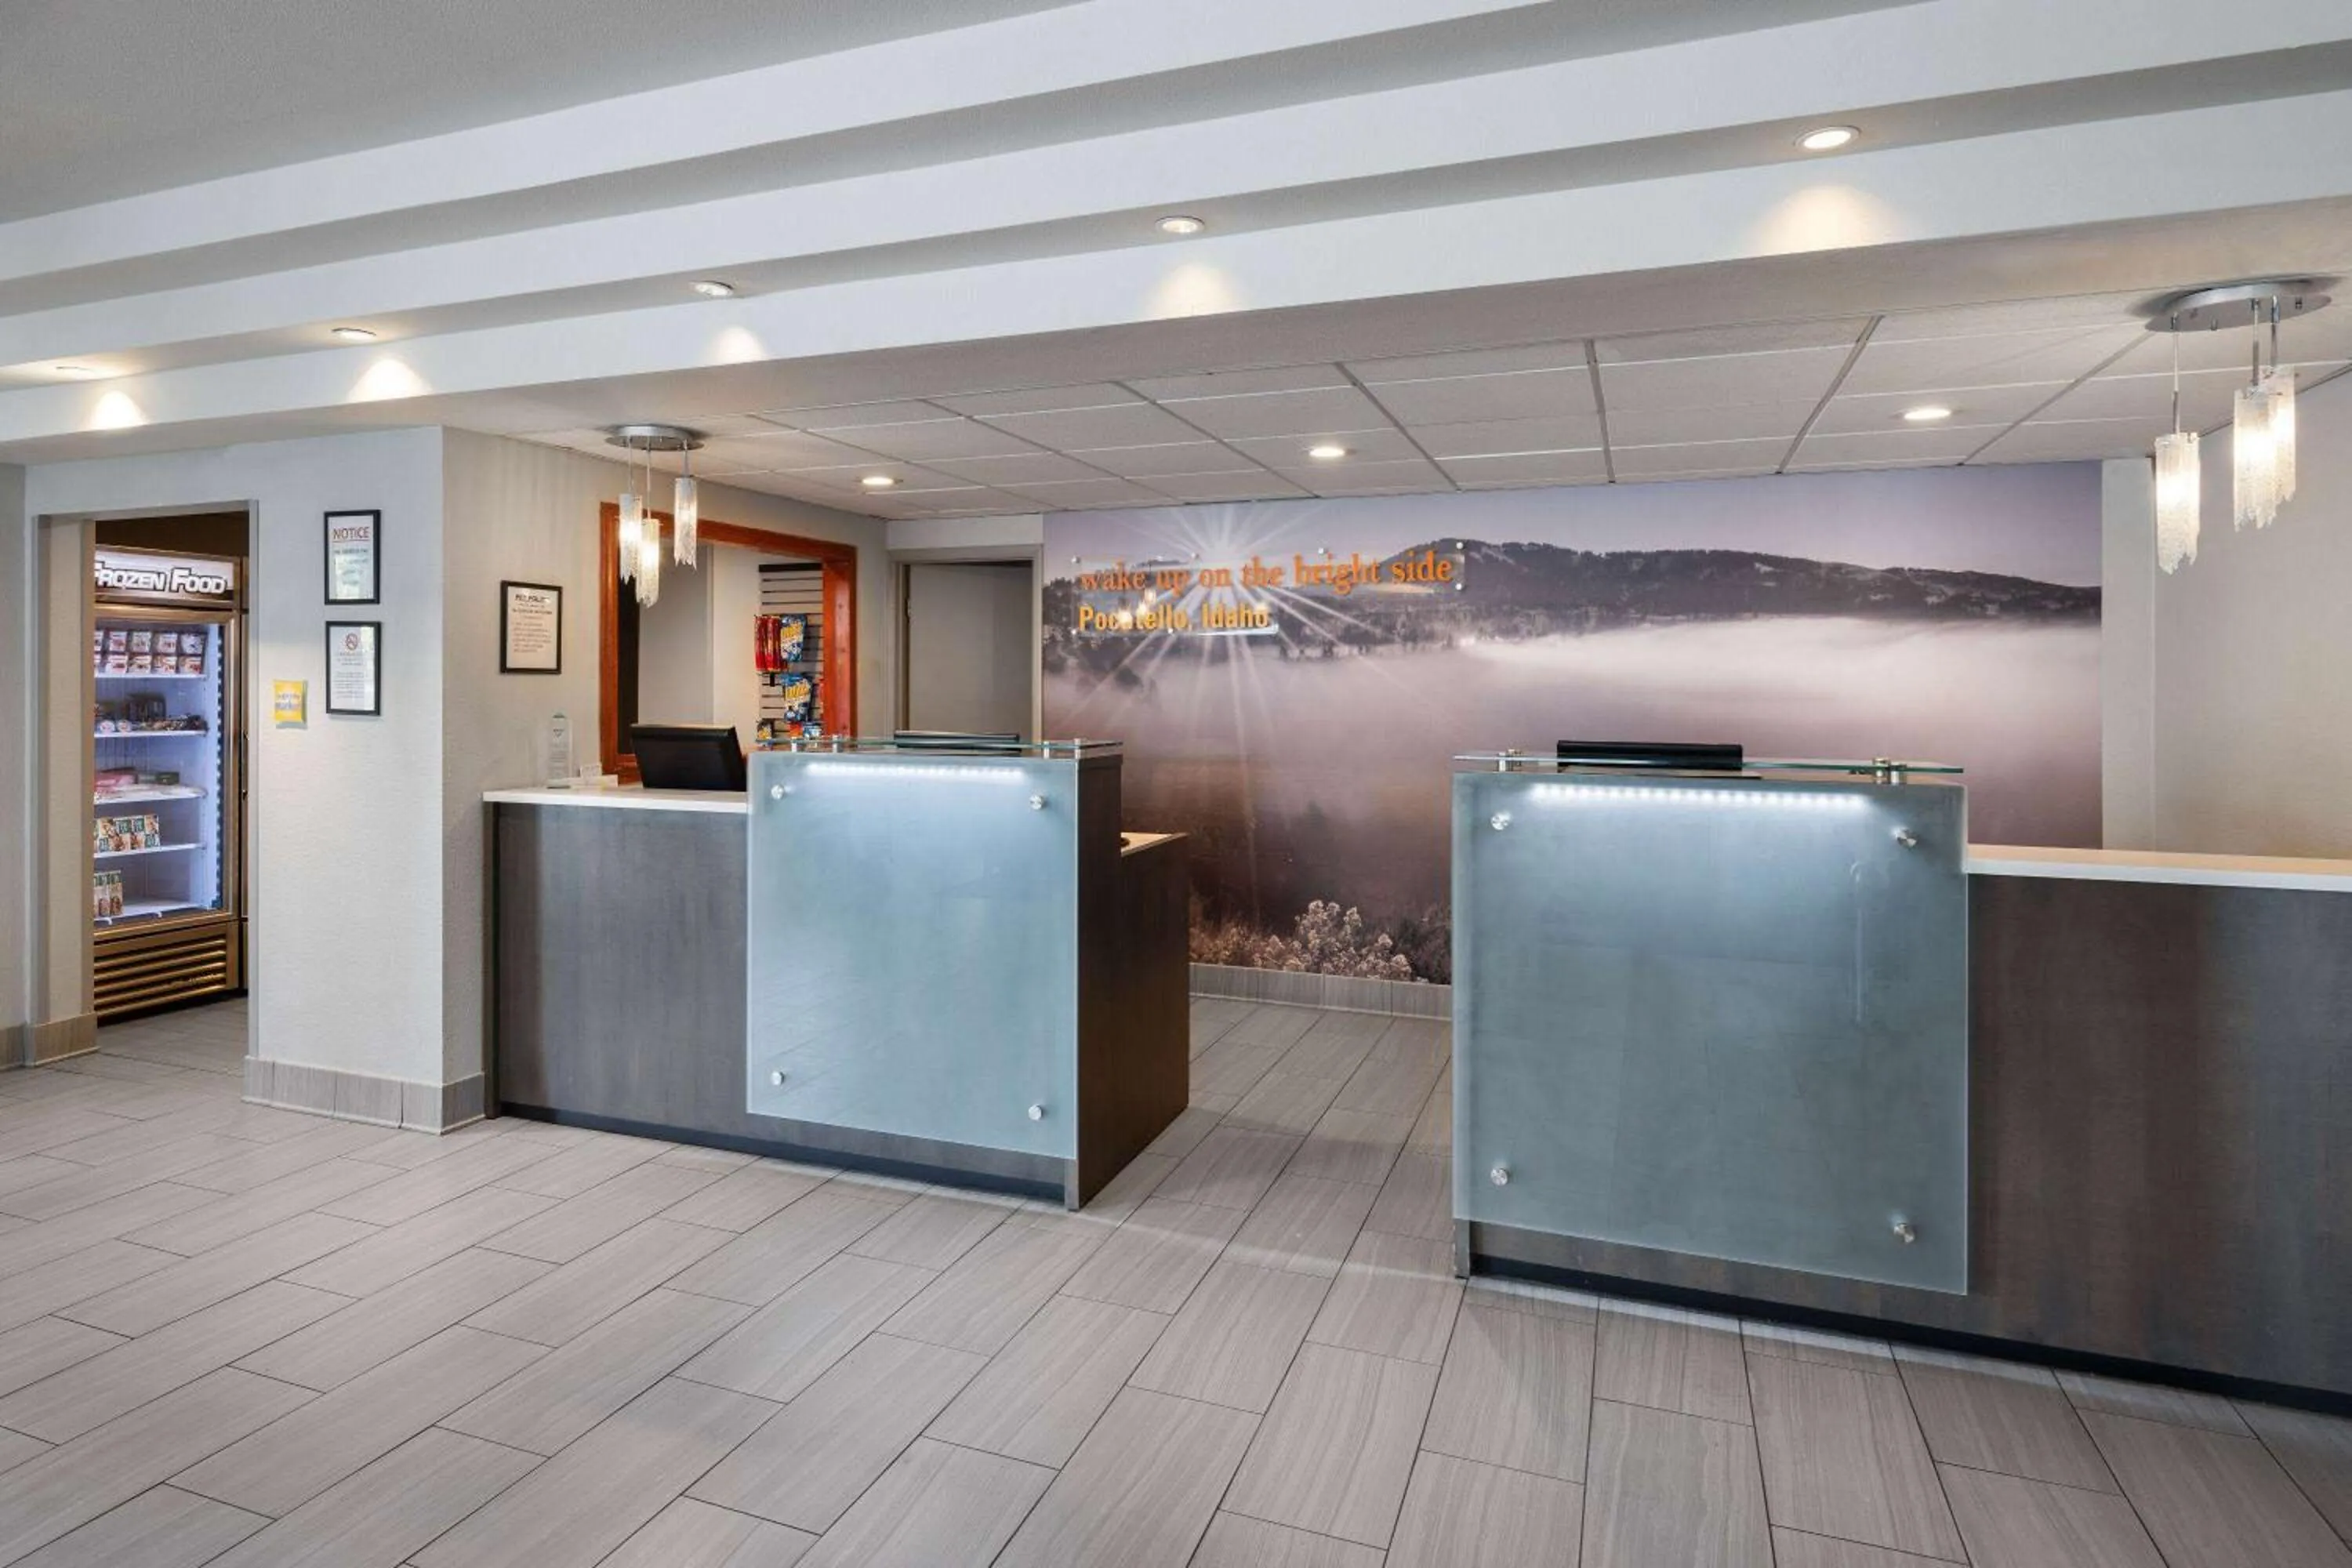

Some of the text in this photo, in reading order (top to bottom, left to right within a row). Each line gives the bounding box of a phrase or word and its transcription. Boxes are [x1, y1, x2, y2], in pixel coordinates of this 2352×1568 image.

[333, 526, 369, 540] NOTICE
[1081, 550, 1450, 597] wake up on the bright side
[1080, 601, 1269, 632] Poctello, Idaho
